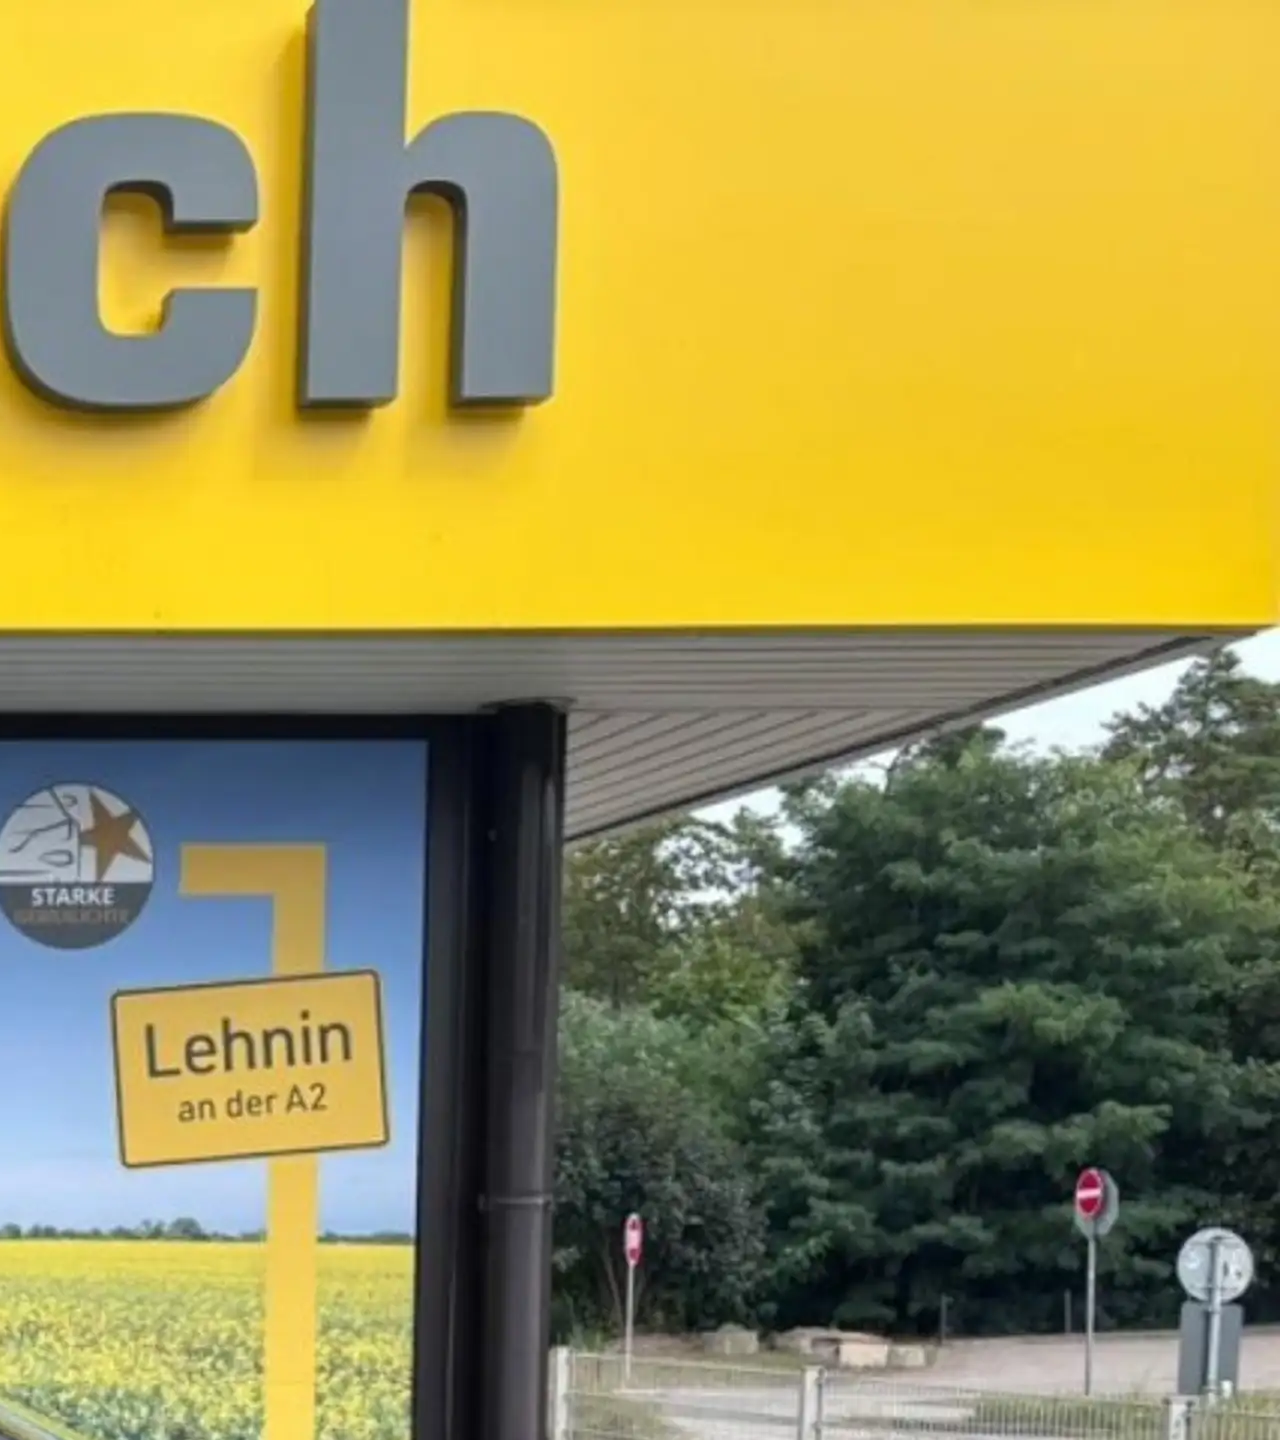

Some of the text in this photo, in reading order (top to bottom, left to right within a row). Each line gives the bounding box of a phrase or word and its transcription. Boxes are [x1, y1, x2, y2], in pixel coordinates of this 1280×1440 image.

[31, 887, 116, 907] STARKE
[145, 1009, 353, 1078] Lehnin
[177, 1081, 329, 1123] an der A2
